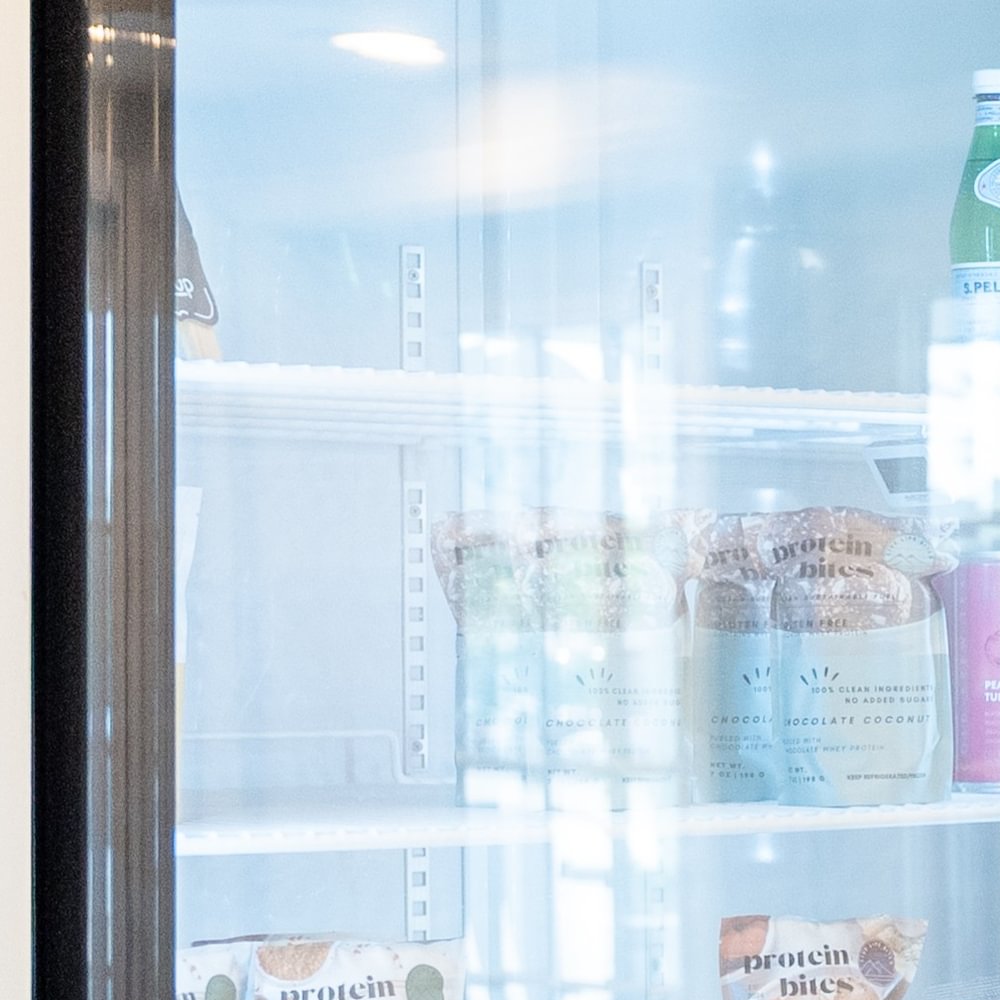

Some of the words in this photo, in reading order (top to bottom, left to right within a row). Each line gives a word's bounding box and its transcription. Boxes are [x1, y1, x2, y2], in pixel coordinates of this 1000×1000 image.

[772, 534, 873, 564] protein
[799, 556, 875, 579] bites
[838, 686, 871, 694] CLEAN
[844, 697, 859, 705] NO
[862, 697, 896, 705] ADDED
[863, 714, 931, 726] COCONUT
[744, 943, 850, 975] protein
[779, 973, 855, 998] bites
